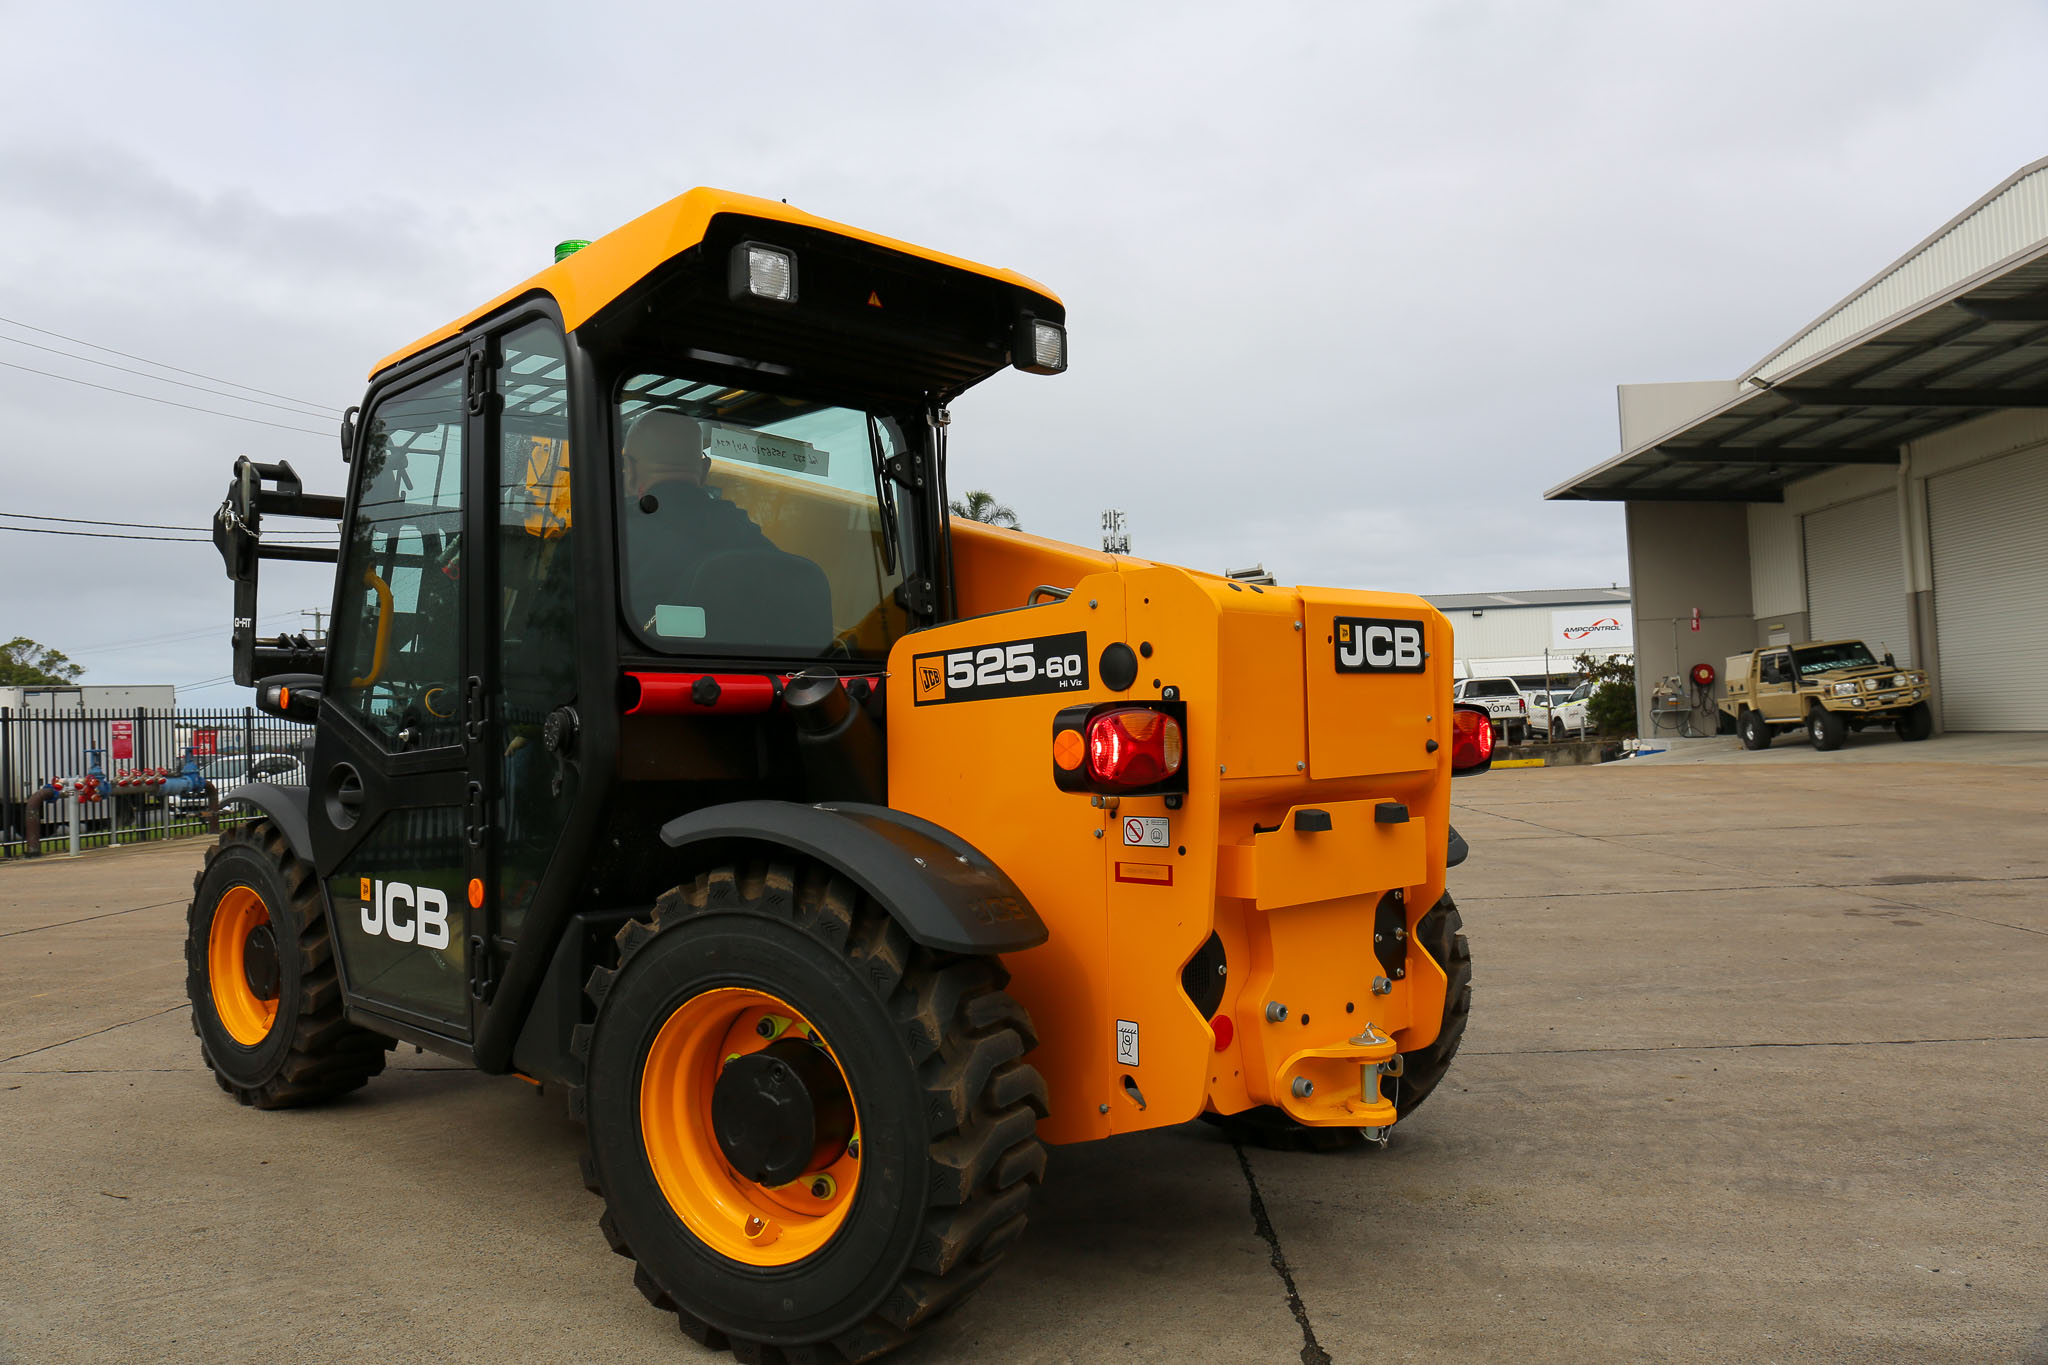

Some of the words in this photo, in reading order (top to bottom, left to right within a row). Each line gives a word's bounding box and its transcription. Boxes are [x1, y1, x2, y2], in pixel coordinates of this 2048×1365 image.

[1563, 625, 1622, 633] AMPCONTROL
[1340, 625, 1422, 667] JCB
[922, 669, 941, 690] JCB
[1059, 680, 1068, 688] Hi
[1070, 679, 1083, 687] Viz
[1486, 704, 1512, 713] YOTA
[361, 879, 450, 950] JCB
